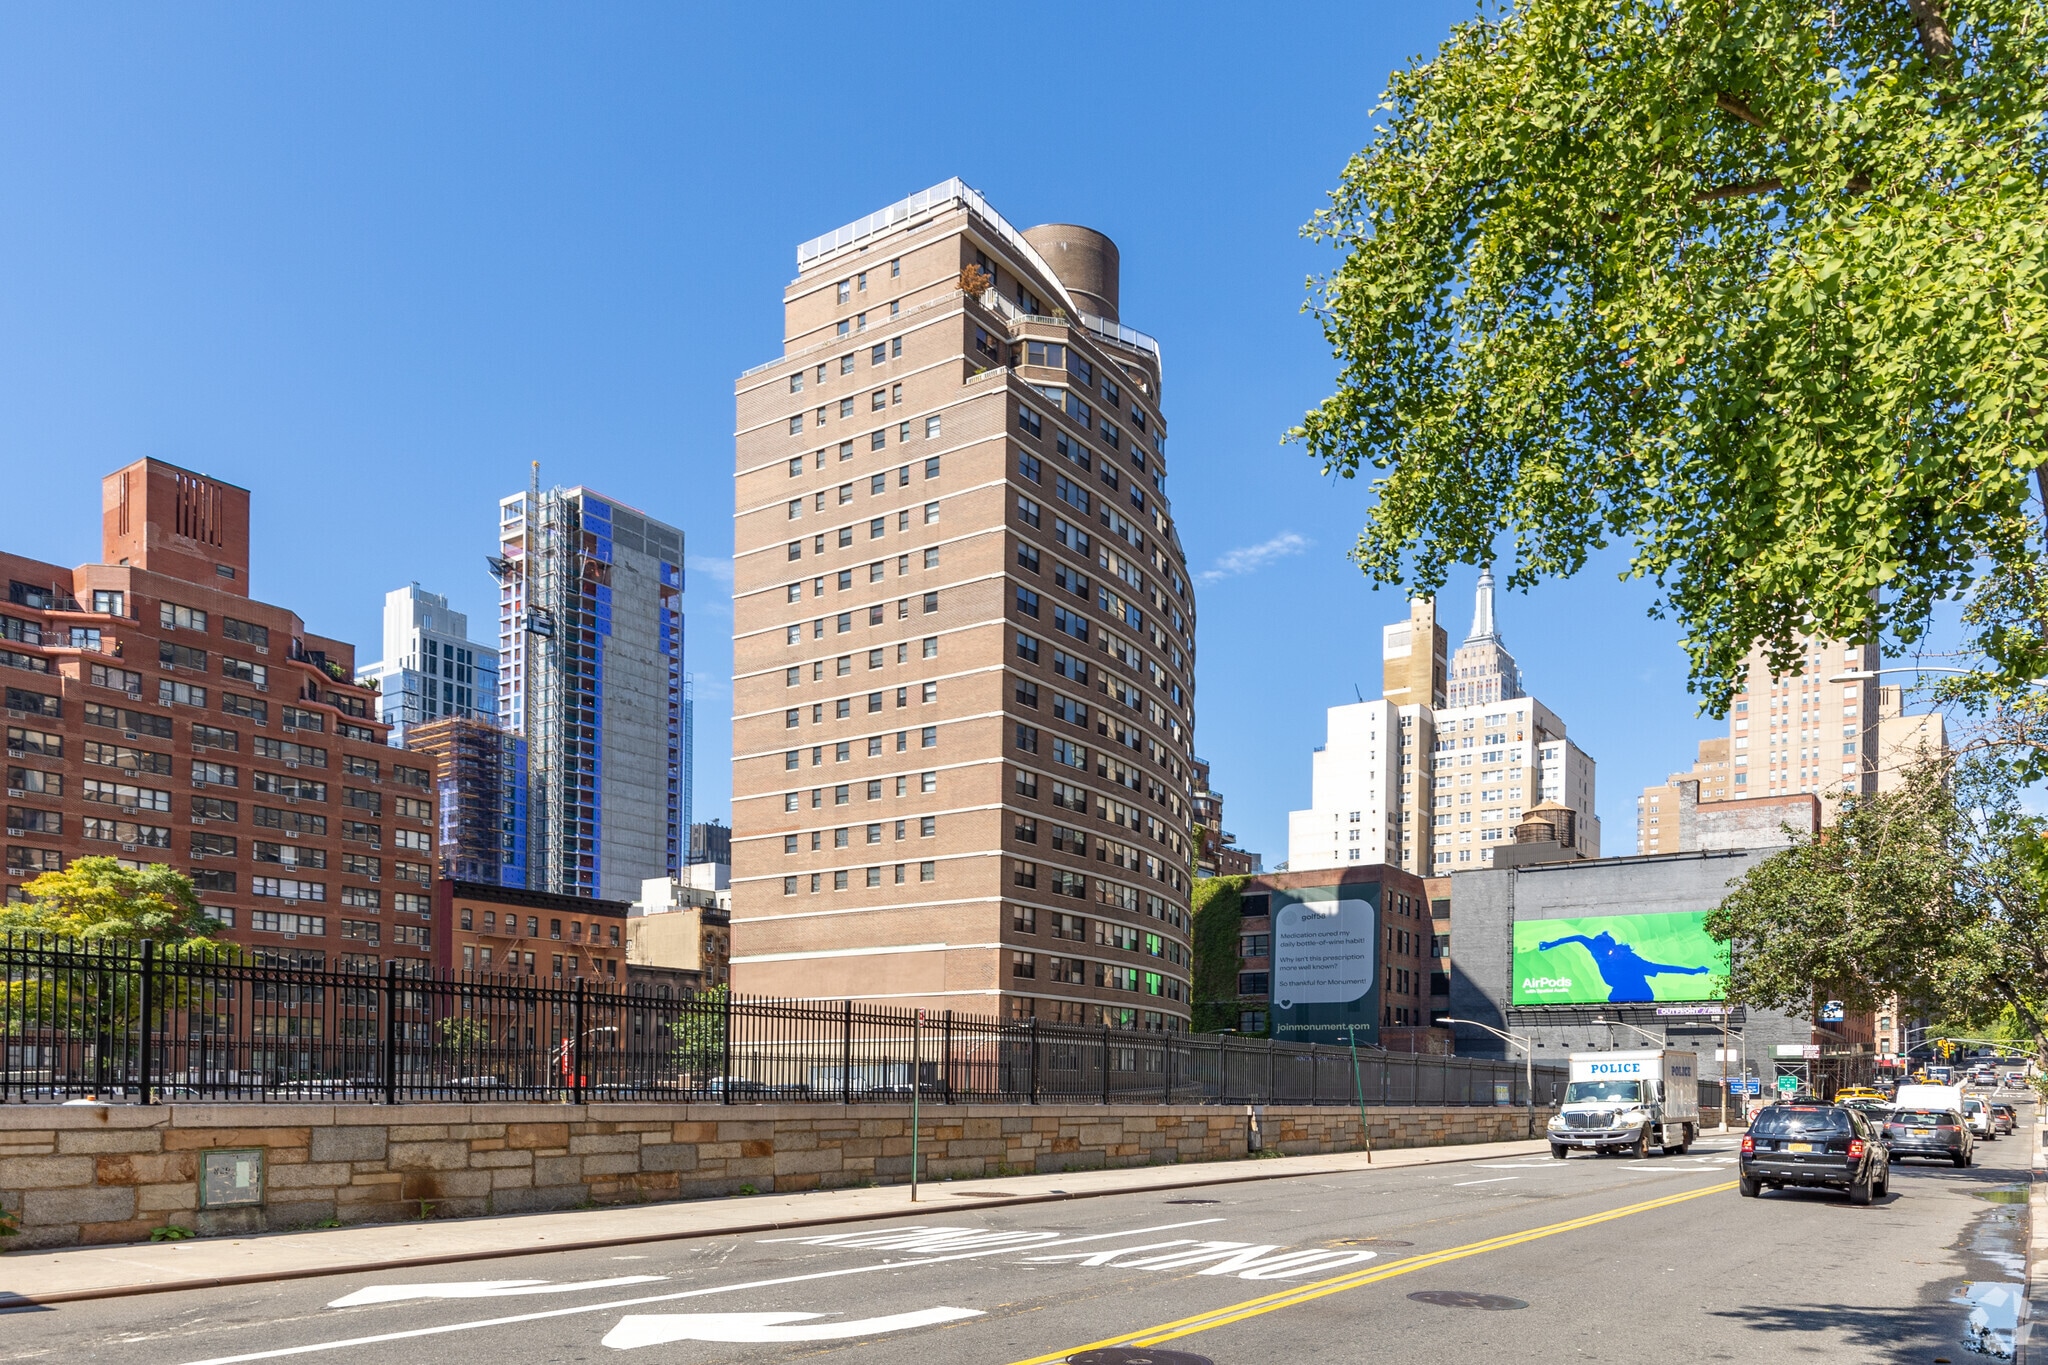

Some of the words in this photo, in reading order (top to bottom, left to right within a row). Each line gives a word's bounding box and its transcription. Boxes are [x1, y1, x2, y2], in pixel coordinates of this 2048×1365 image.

[1296, 939, 1344, 947] bottle-of-wine
[1322, 954, 1365, 962] prescription
[1522, 976, 1572, 988] AirPods
[1276, 1022, 1370, 1034] joinmonument.com
[1591, 1063, 1640, 1073] POLICE
[1671, 1065, 1691, 1077] POLICE
[1022, 1239, 1378, 1280] ONLY
